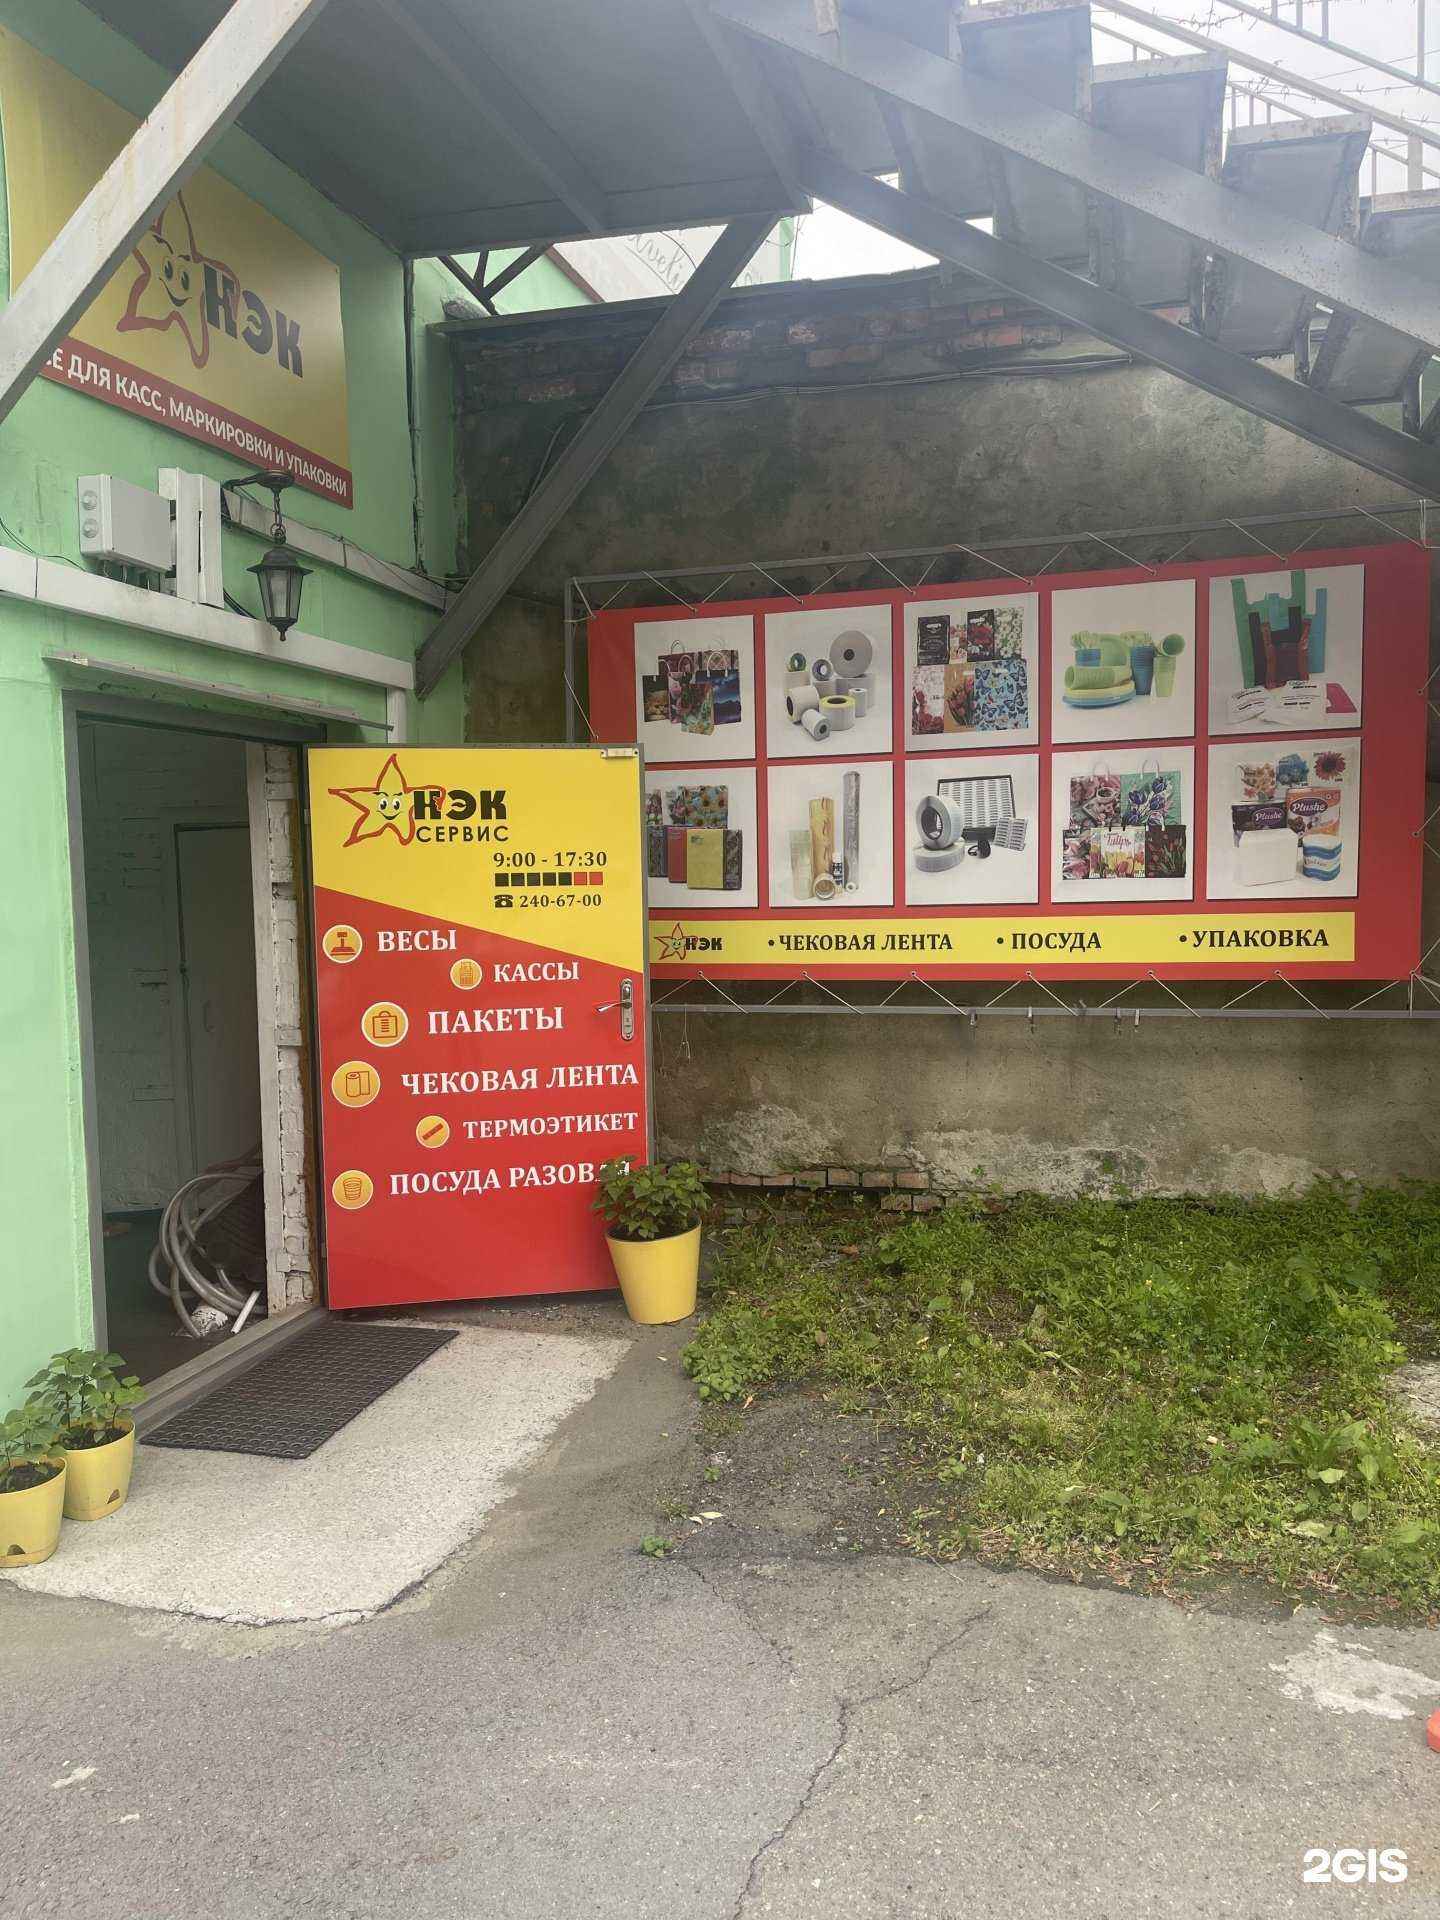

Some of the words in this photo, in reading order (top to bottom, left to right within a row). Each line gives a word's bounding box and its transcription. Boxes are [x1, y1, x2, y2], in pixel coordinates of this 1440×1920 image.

[204, 263, 303, 378] НЭК
[67, 353, 111, 391] ДЛЯ
[116, 373, 166, 417] КАСС,
[169, 397, 273, 462] МАРКИРОВКИ
[275, 445, 284, 466] И
[286, 453, 348, 497] УПАКОВКИ
[414, 789, 507, 821] НЭК
[416, 825, 509, 843] СЕРВИС
[493, 852, 536, 868] 9:00
[554, 851, 607, 868] 17:30
[519, 894, 602, 908] 240-67-00
[376, 929, 457, 952] ВЕСЫ
[685, 937, 723, 951] НЭК
[779, 934, 876, 951] ЧЕКОВАЯ
[881, 933, 954, 951] ЛЕНТА
[1011, 932, 1103, 953] ПОСУДА
[1192, 929, 1330, 950] УПАКОВКА
[493, 961, 580, 983] КАССЫ
[428, 1006, 564, 1035] ПАКЕТЫ
[401, 1068, 539, 1096] ЧЕКОВАЯ
[546, 1063, 639, 1089] ЛЕНТА
[463, 1112, 639, 1140] ТЕРМОЭТИКЕТ
[389, 1168, 502, 1195] ПОСУДА
[509, 1160, 630, 1188] РАЗОВ
